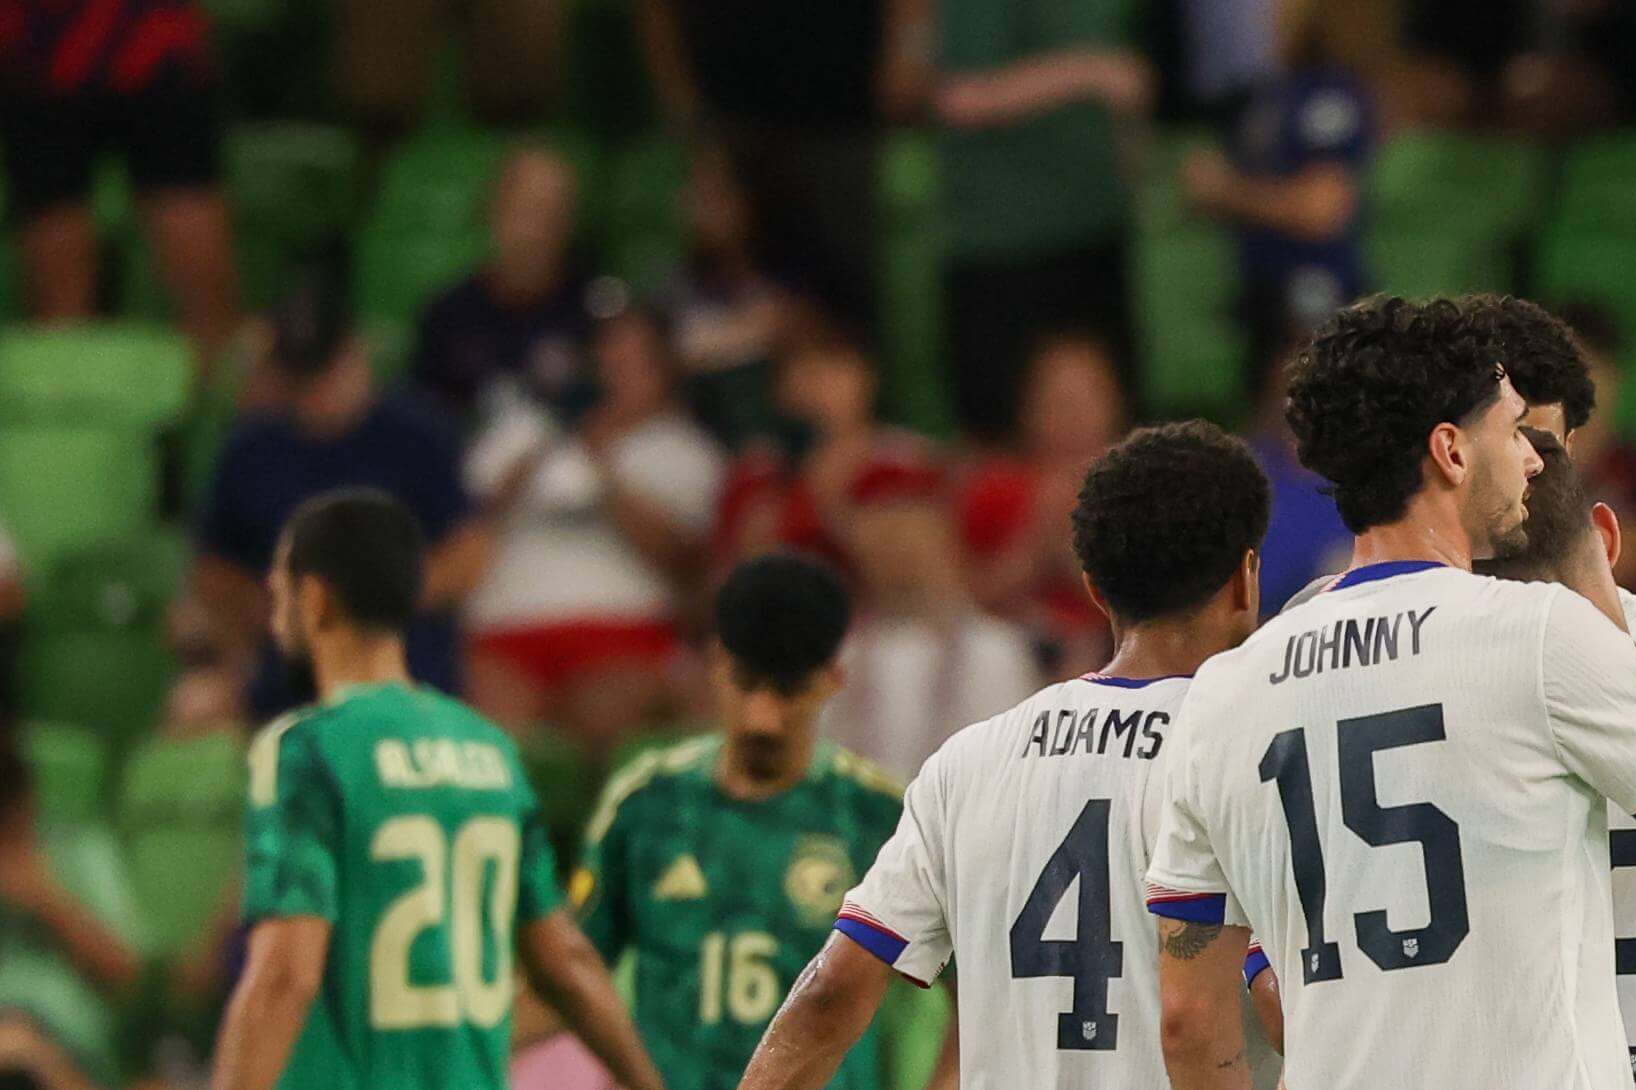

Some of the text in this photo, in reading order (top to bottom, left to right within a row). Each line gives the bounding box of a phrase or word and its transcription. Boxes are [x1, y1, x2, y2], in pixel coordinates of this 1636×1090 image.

[1269, 606, 1437, 685] JOHNNY
[1022, 708, 1171, 760] ADAMS
[1259, 703, 1469, 986] 15
[370, 814, 522, 1032] 20
[700, 932, 779, 1025] 16
[1009, 799, 1123, 1050] 4
